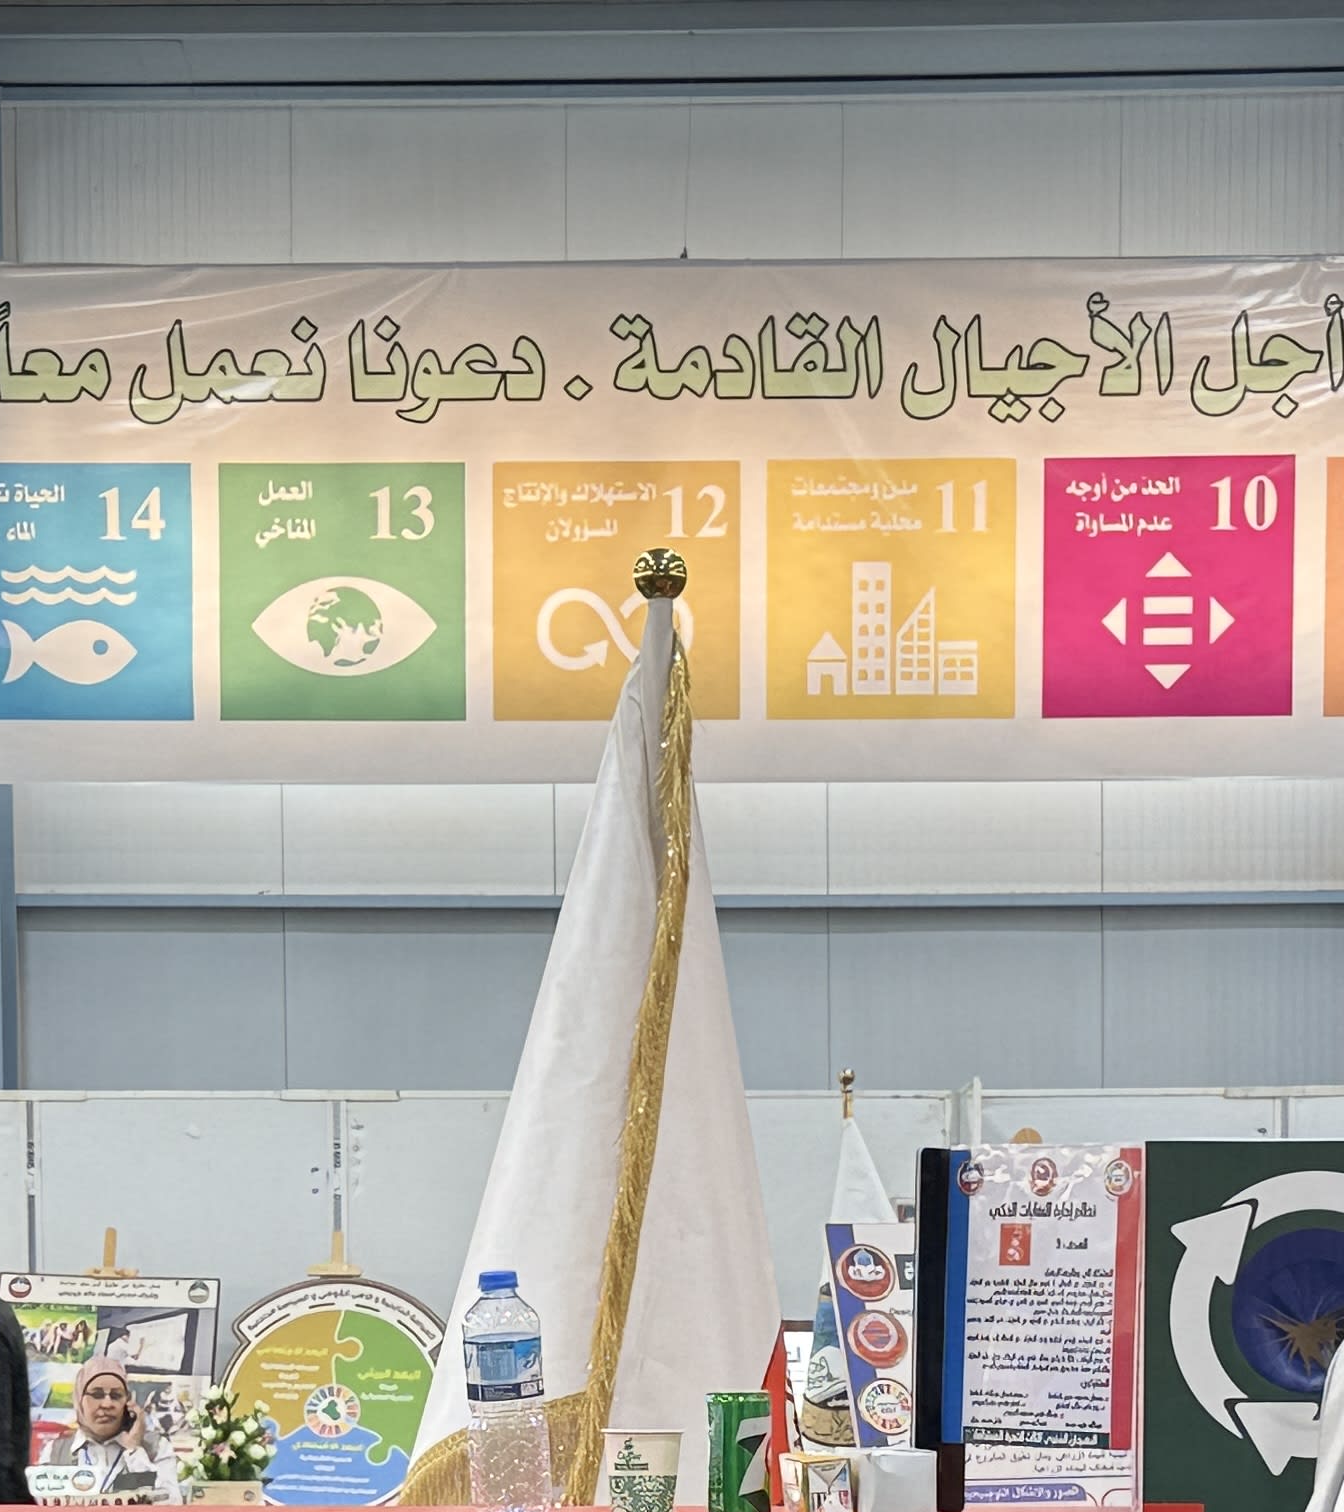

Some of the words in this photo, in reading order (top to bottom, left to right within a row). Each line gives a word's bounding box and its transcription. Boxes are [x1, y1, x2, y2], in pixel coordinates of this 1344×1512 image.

[129, 316, 327, 424] نعمل
[349, 316, 545, 422] دعونا
[611, 311, 883, 400] القادمة
[901, 292, 1174, 422] الأجيال
[13, 483, 65, 509] الحياة
[98, 486, 166, 541] 14
[258, 479, 313, 507] العمل
[369, 485, 435, 541] 13
[663, 483, 729, 539] 12
[935, 479, 990, 533] 11
[1110, 478, 1138, 502] من
[1209, 474, 1278, 532] 10
